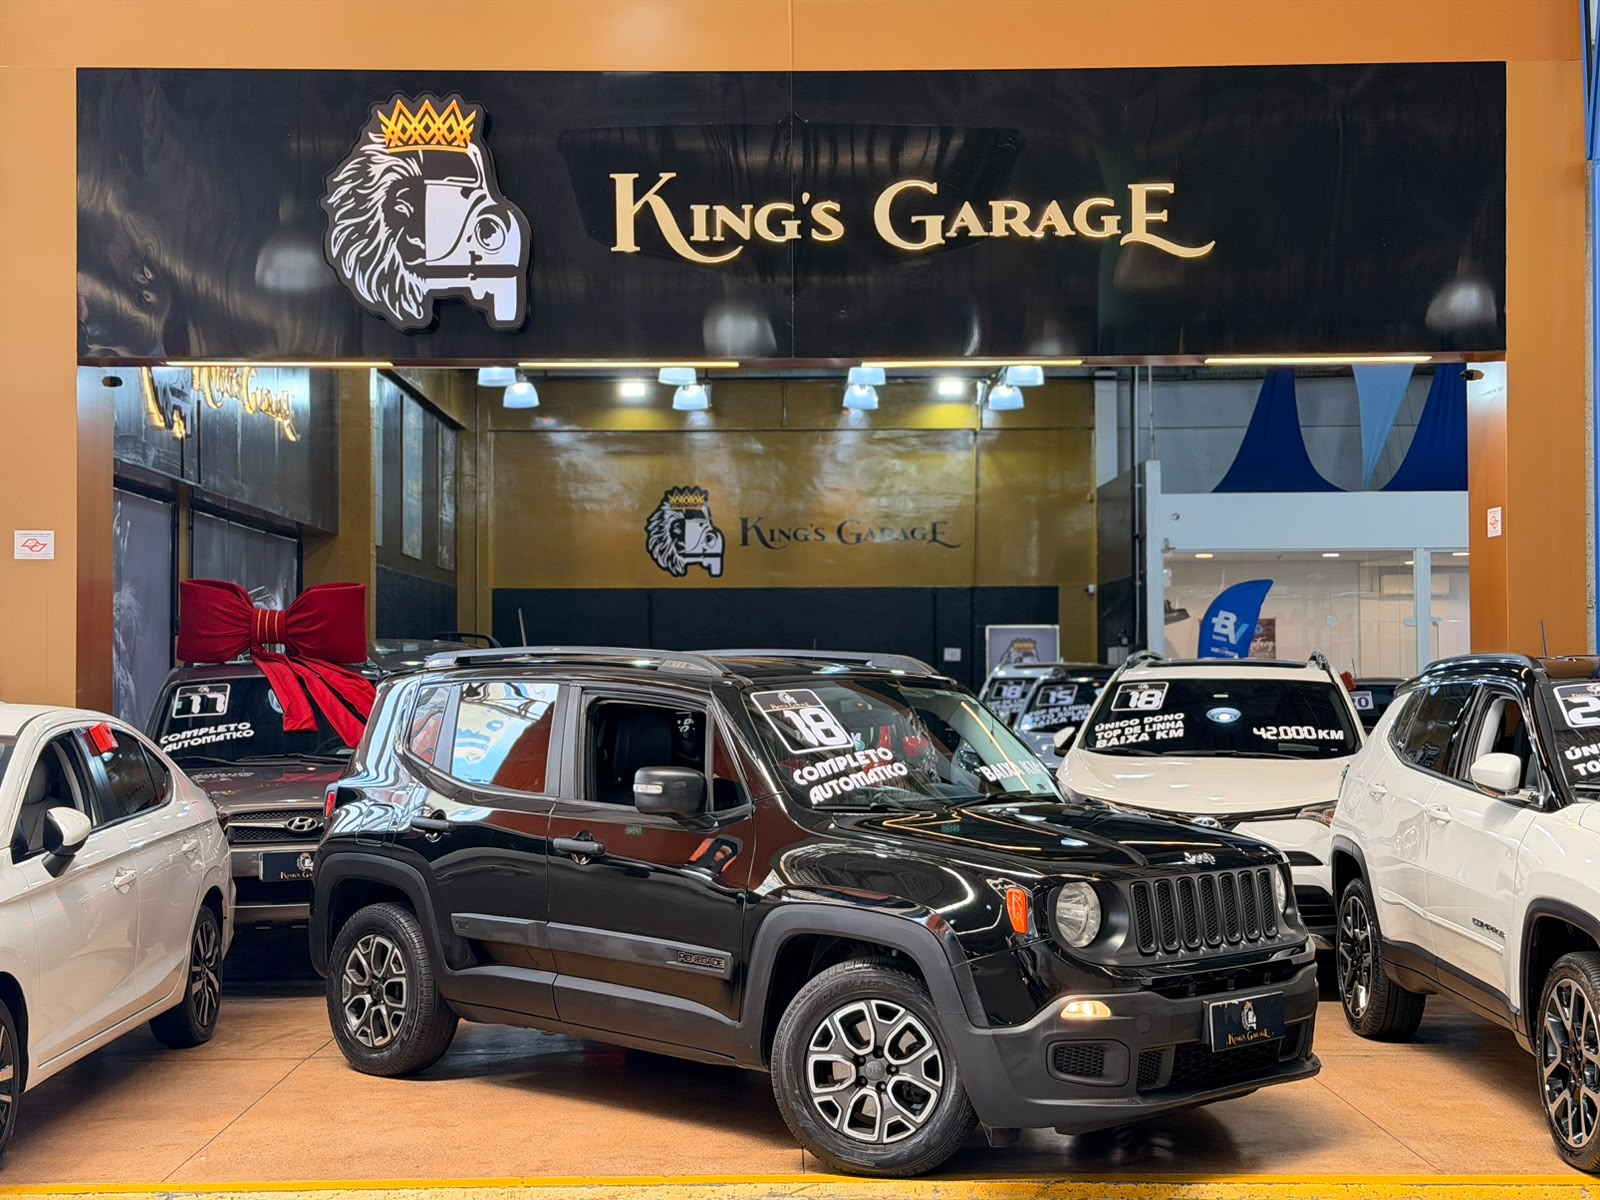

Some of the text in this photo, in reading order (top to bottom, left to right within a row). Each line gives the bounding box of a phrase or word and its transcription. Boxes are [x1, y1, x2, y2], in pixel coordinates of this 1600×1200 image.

[873, 179, 1216, 258] GARAGE
[1002, 685, 1022, 698] 18
[1049, 690, 1073, 704] 15
[1129, 690, 1162, 708] 18
[190, 693, 226, 714] 17
[783, 707, 847, 746] 18
[1094, 712, 1185, 732] ÚNICO DONO
[1095, 720, 1184, 740] TOP DE LINHA
[159, 722, 251, 744] COMPLETO
[163, 729, 255, 753] AUTOMATICO
[1095, 728, 1184, 749] BAIXA KM
[1317, 729, 1344, 741] KM
[793, 747, 893, 785] COMPLETO
[809, 762, 908, 805] AUTOMATICO
[678, 951, 725, 969] RENEGADE
